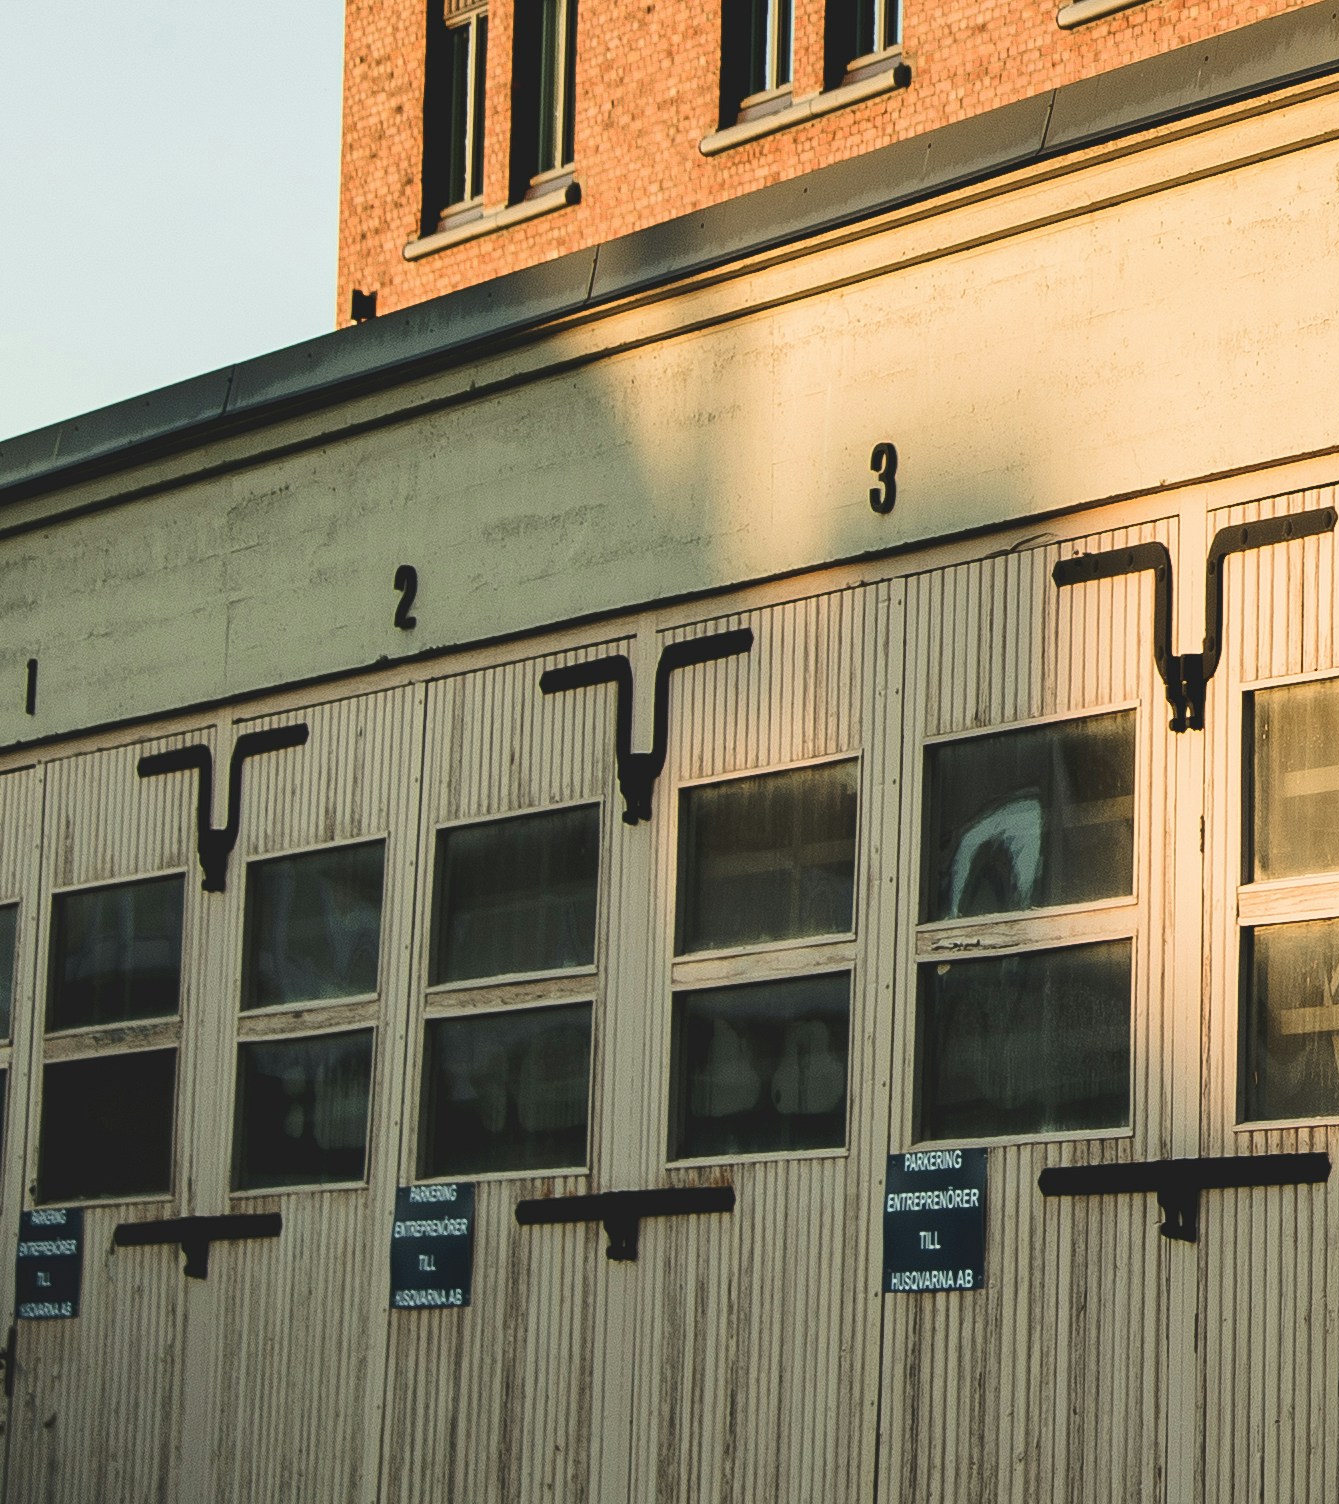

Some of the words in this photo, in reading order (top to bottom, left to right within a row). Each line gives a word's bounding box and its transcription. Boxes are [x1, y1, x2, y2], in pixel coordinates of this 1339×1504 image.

[869, 442, 898, 515] 3
[393, 565, 418, 631] 2
[904, 1150, 962, 1172] PARKERING
[919, 1231, 941, 1250] TILL
[891, 1270, 955, 1290] HUSQVARNA
[956, 1269, 974, 1288] AB
